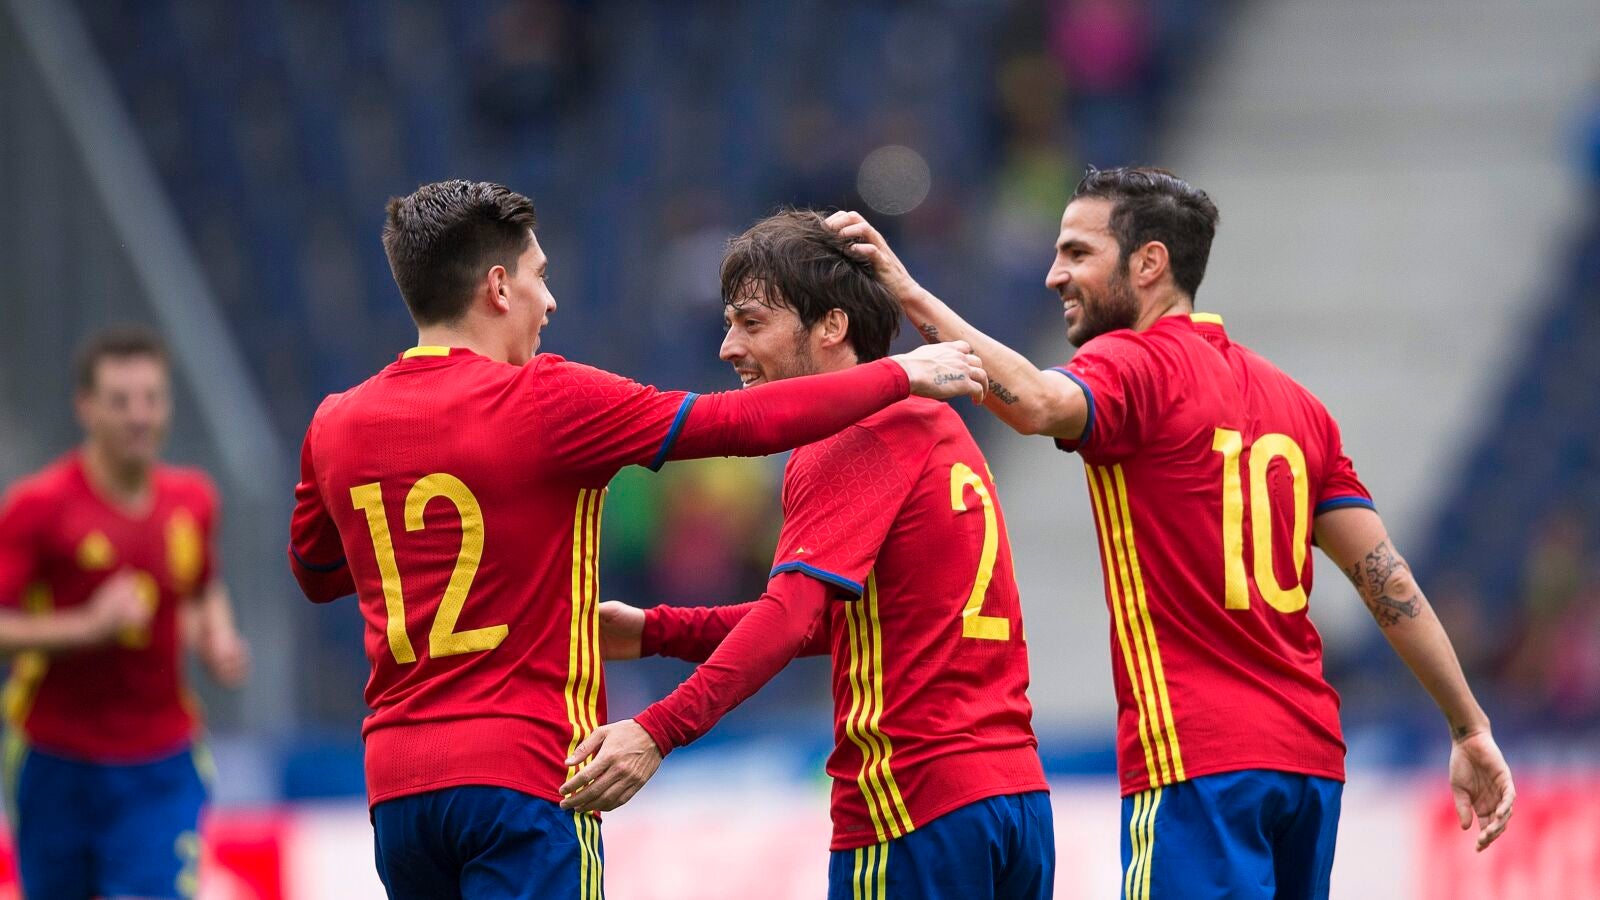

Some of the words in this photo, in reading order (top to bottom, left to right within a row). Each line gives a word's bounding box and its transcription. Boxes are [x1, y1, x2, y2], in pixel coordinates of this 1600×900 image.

[349, 472, 508, 665] 12
[950, 462, 1026, 641] 2
[1211, 427, 1309, 613] 10
